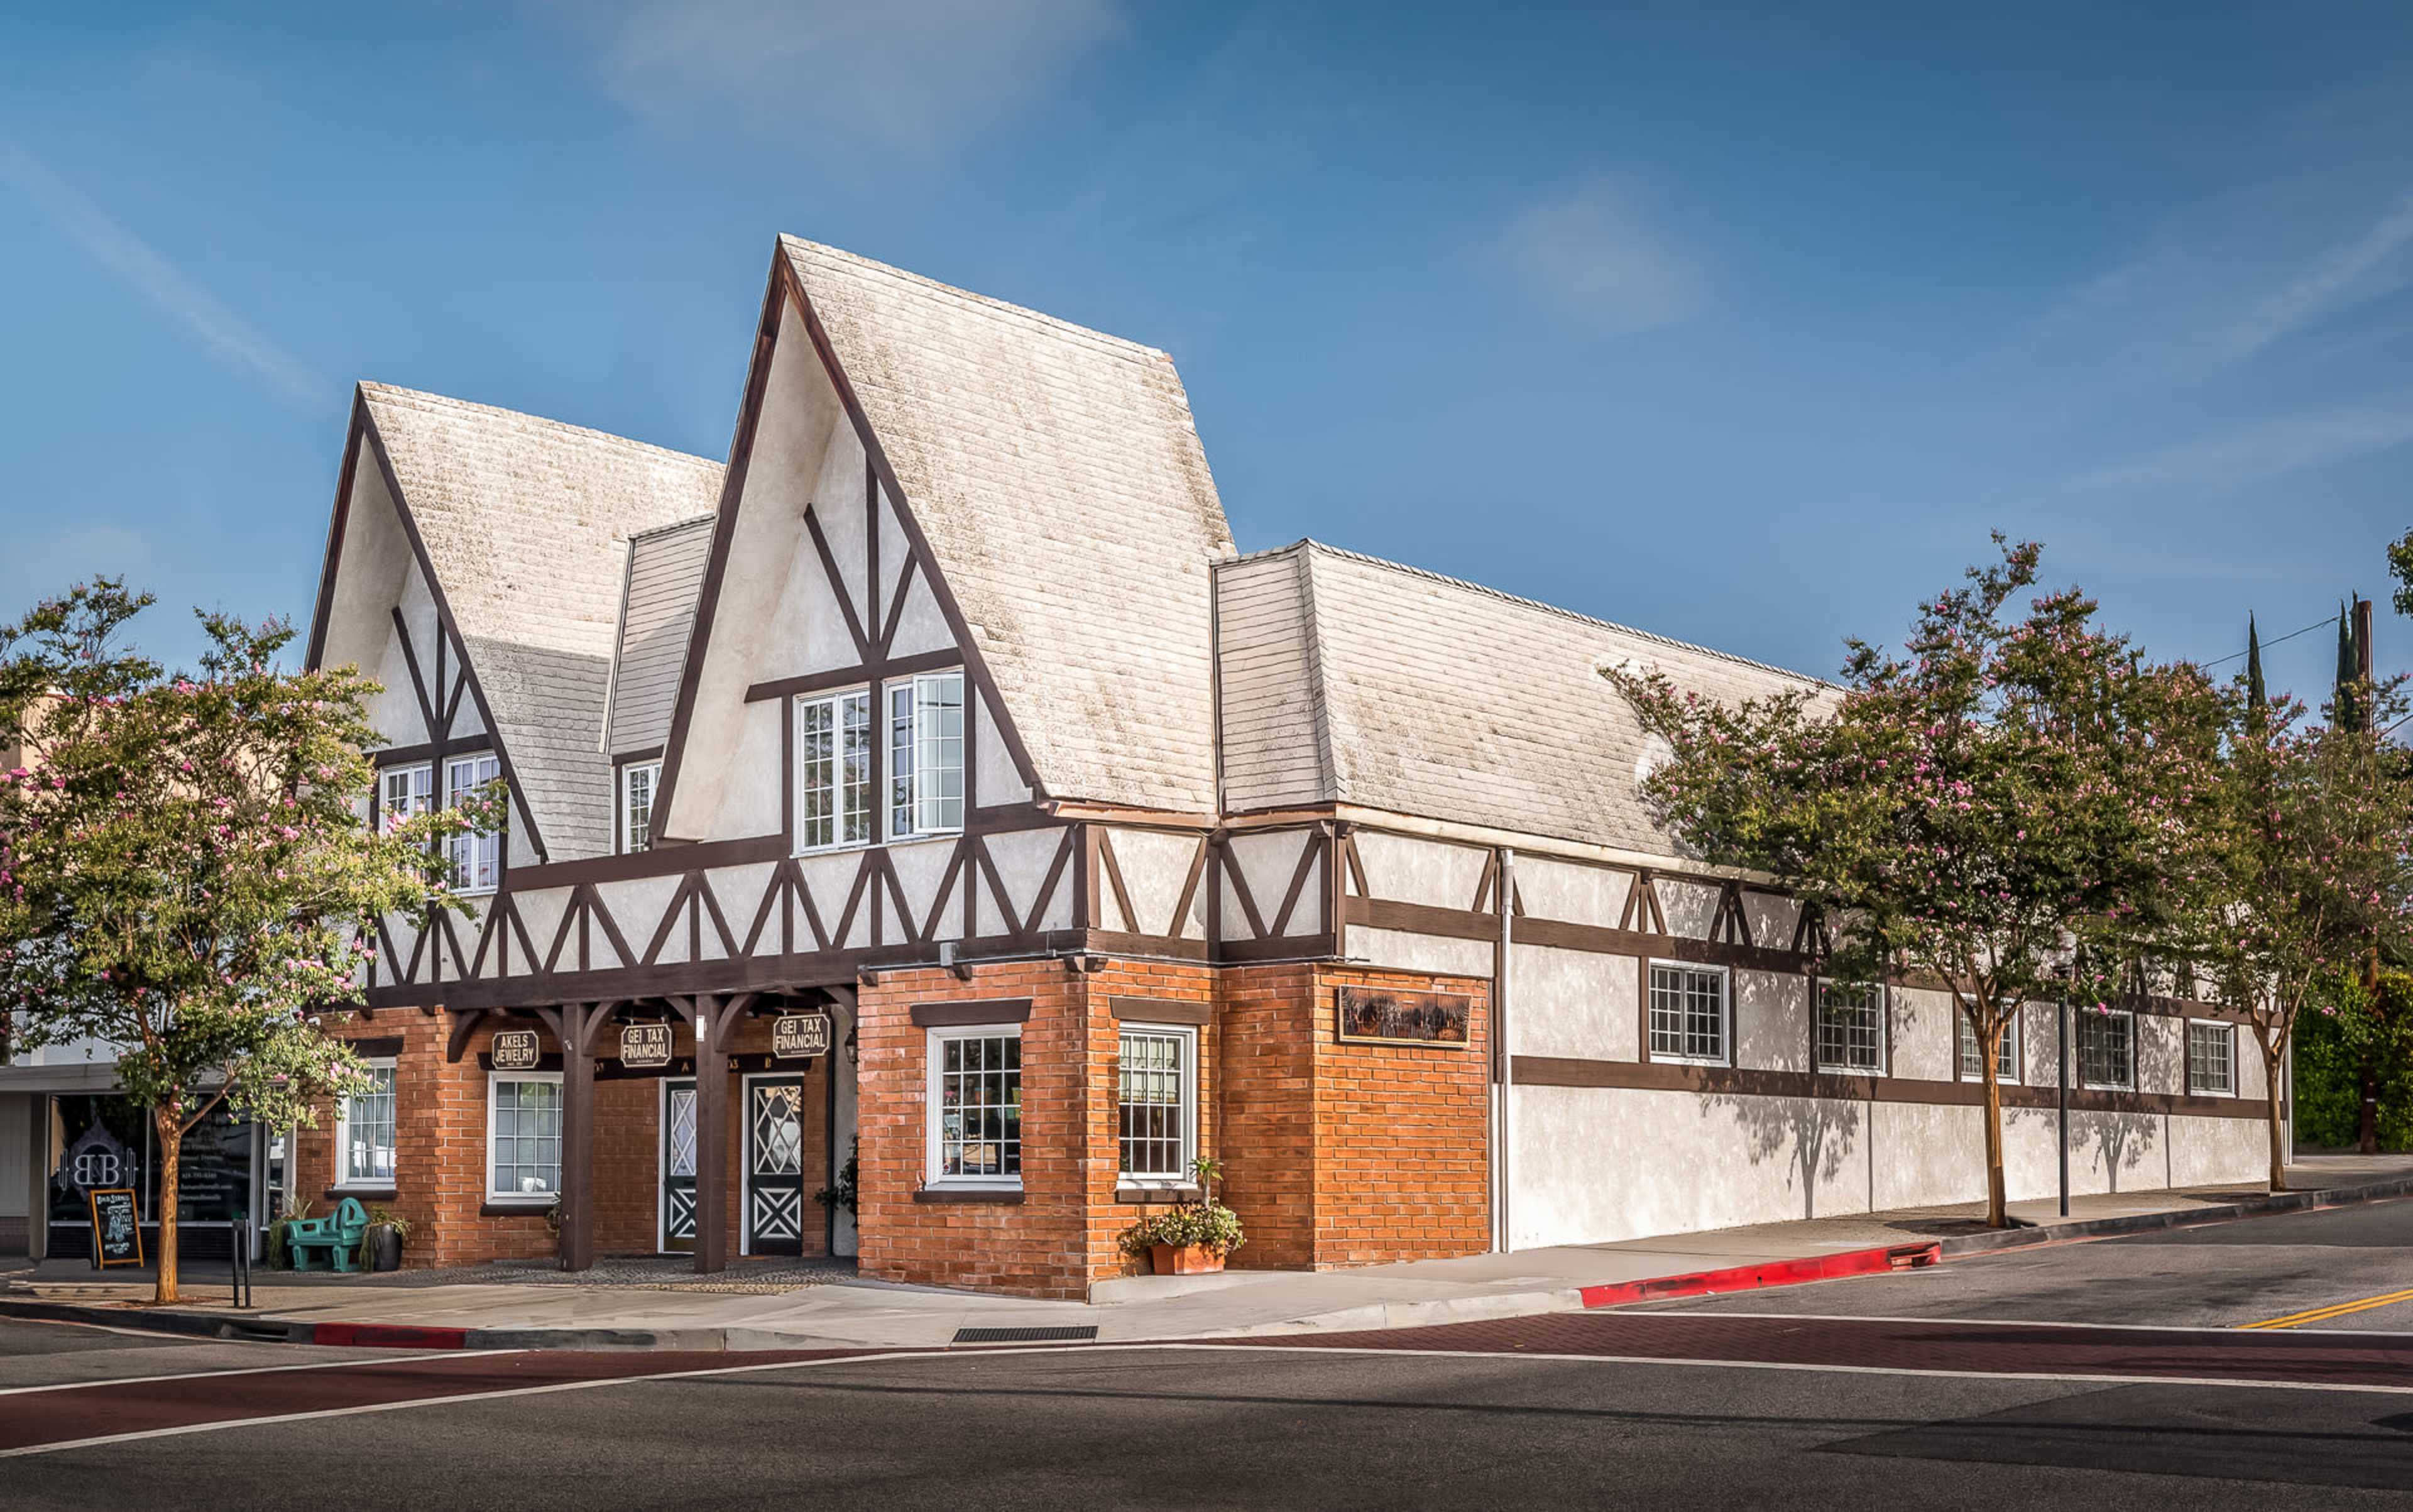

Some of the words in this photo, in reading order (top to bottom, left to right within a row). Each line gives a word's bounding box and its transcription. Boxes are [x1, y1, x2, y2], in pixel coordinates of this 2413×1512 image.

[781, 1020, 796, 1034] GEI
[802, 1018, 821, 1033] TAX
[628, 1029, 642, 1043] GEI
[647, 1027, 664, 1043] TAX
[775, 1033, 825, 1050] FINANCIAL
[495, 1048, 533, 1063] JEWELRY
[623, 1043, 667, 1058] FINANCIAL
